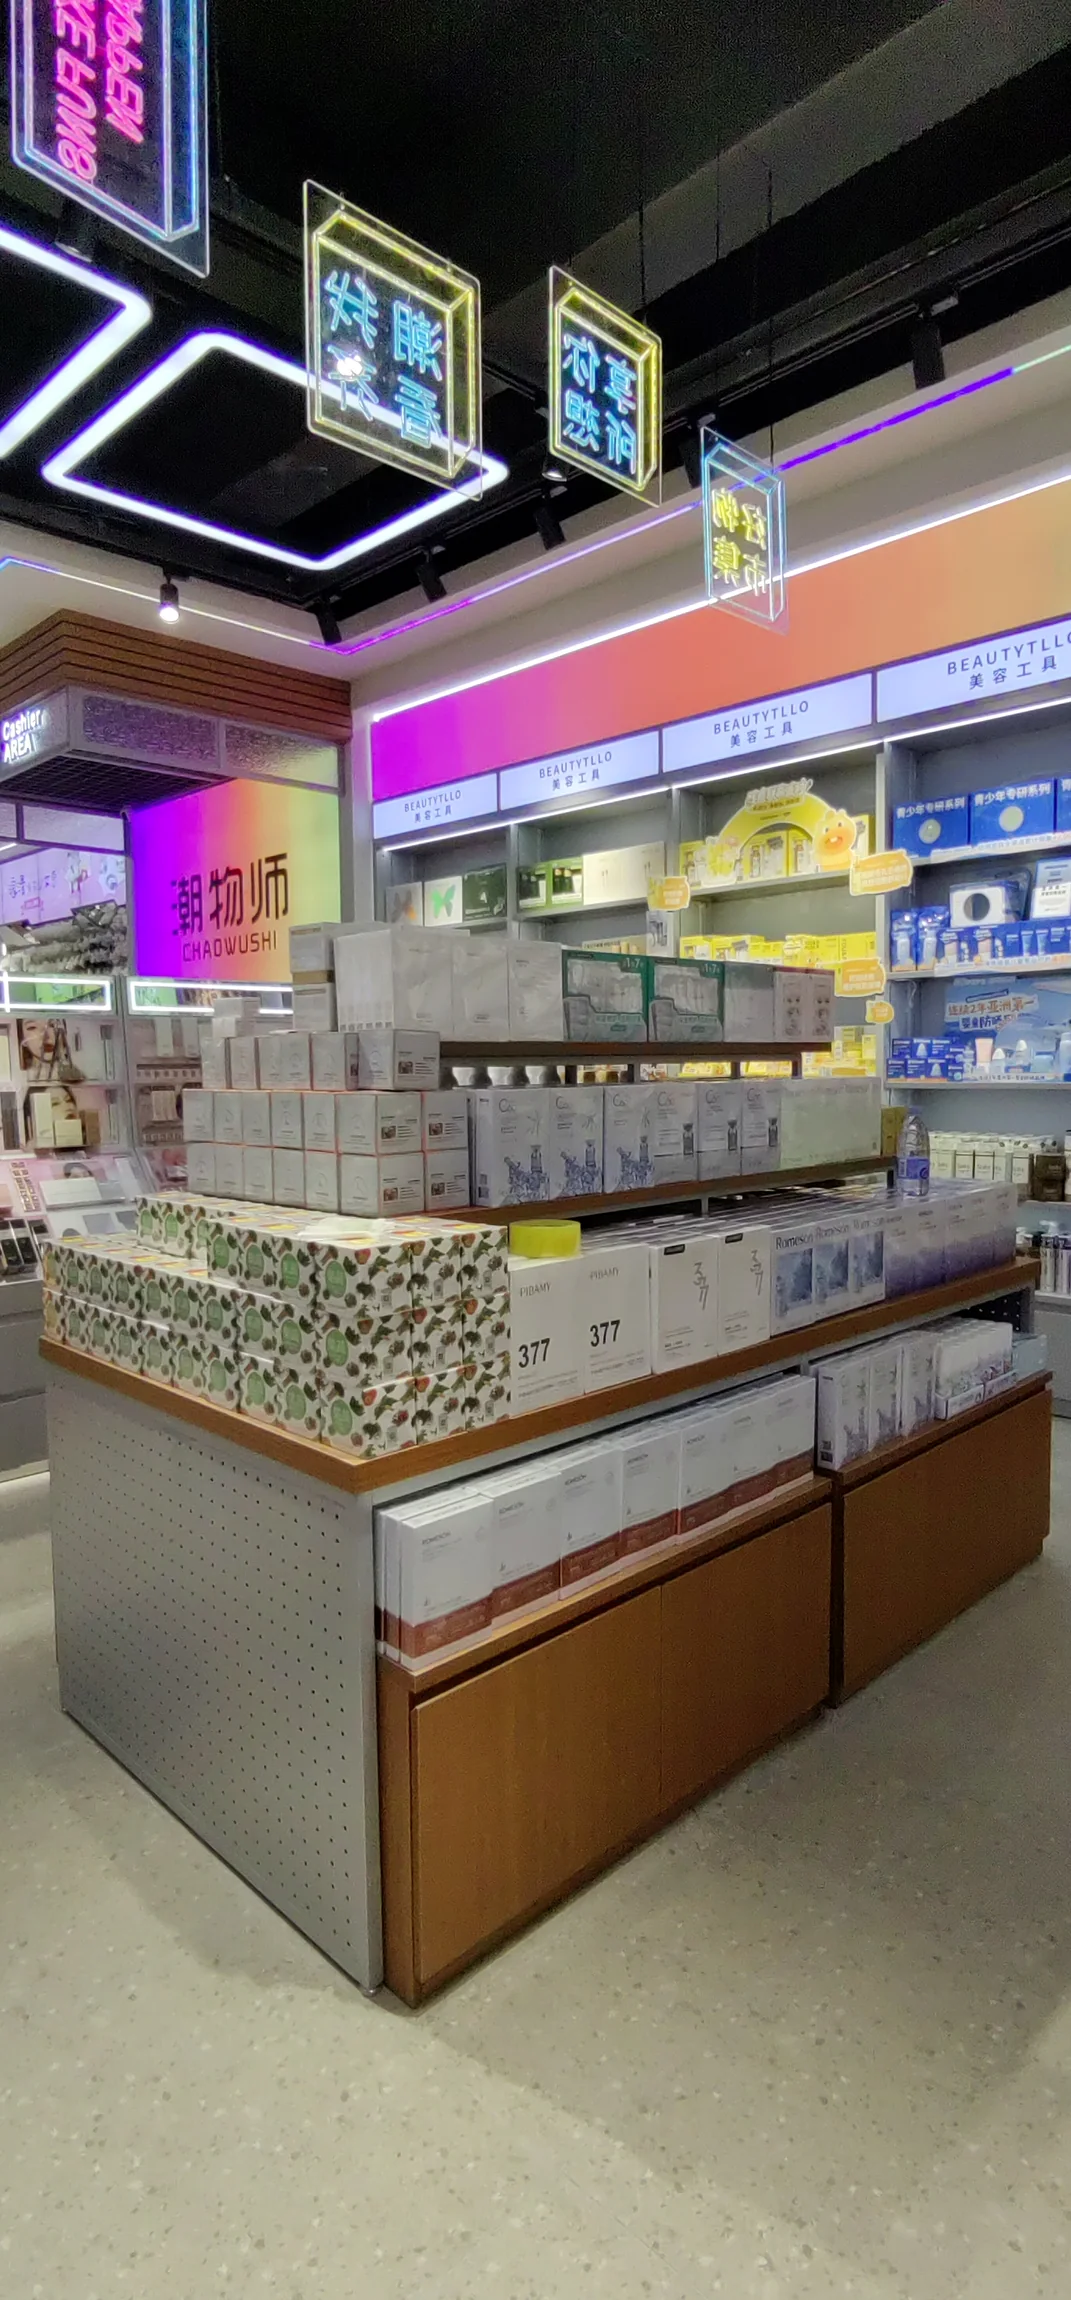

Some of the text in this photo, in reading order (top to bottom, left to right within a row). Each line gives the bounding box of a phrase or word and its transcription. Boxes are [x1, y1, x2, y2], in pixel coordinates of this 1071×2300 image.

[969, 655, 1057, 690] 美容工具
[3, 709, 41, 741] Cashier
[713, 700, 809, 735] BEAUTYTLLO
[4, 733, 32, 764] AREA
[730, 721, 793, 748] 美容工具
[539, 751, 612, 779] BEAUTYTLLO
[552, 769, 600, 791] 美容工具
[404, 790, 462, 813] BEAUTYTLLO
[896, 797, 966, 819] 青少年专研系列
[974, 782, 1051, 807] 青少年专研系列
[414, 805, 452, 824] 美容工具
[171, 853, 289, 936] 潮物师
[182, 930, 277, 962] CHAOWUSHI
[519, 1282, 551, 1298] PIBAMY
[589, 1319, 621, 1348] 377
[518, 1337, 551, 1368] 377
